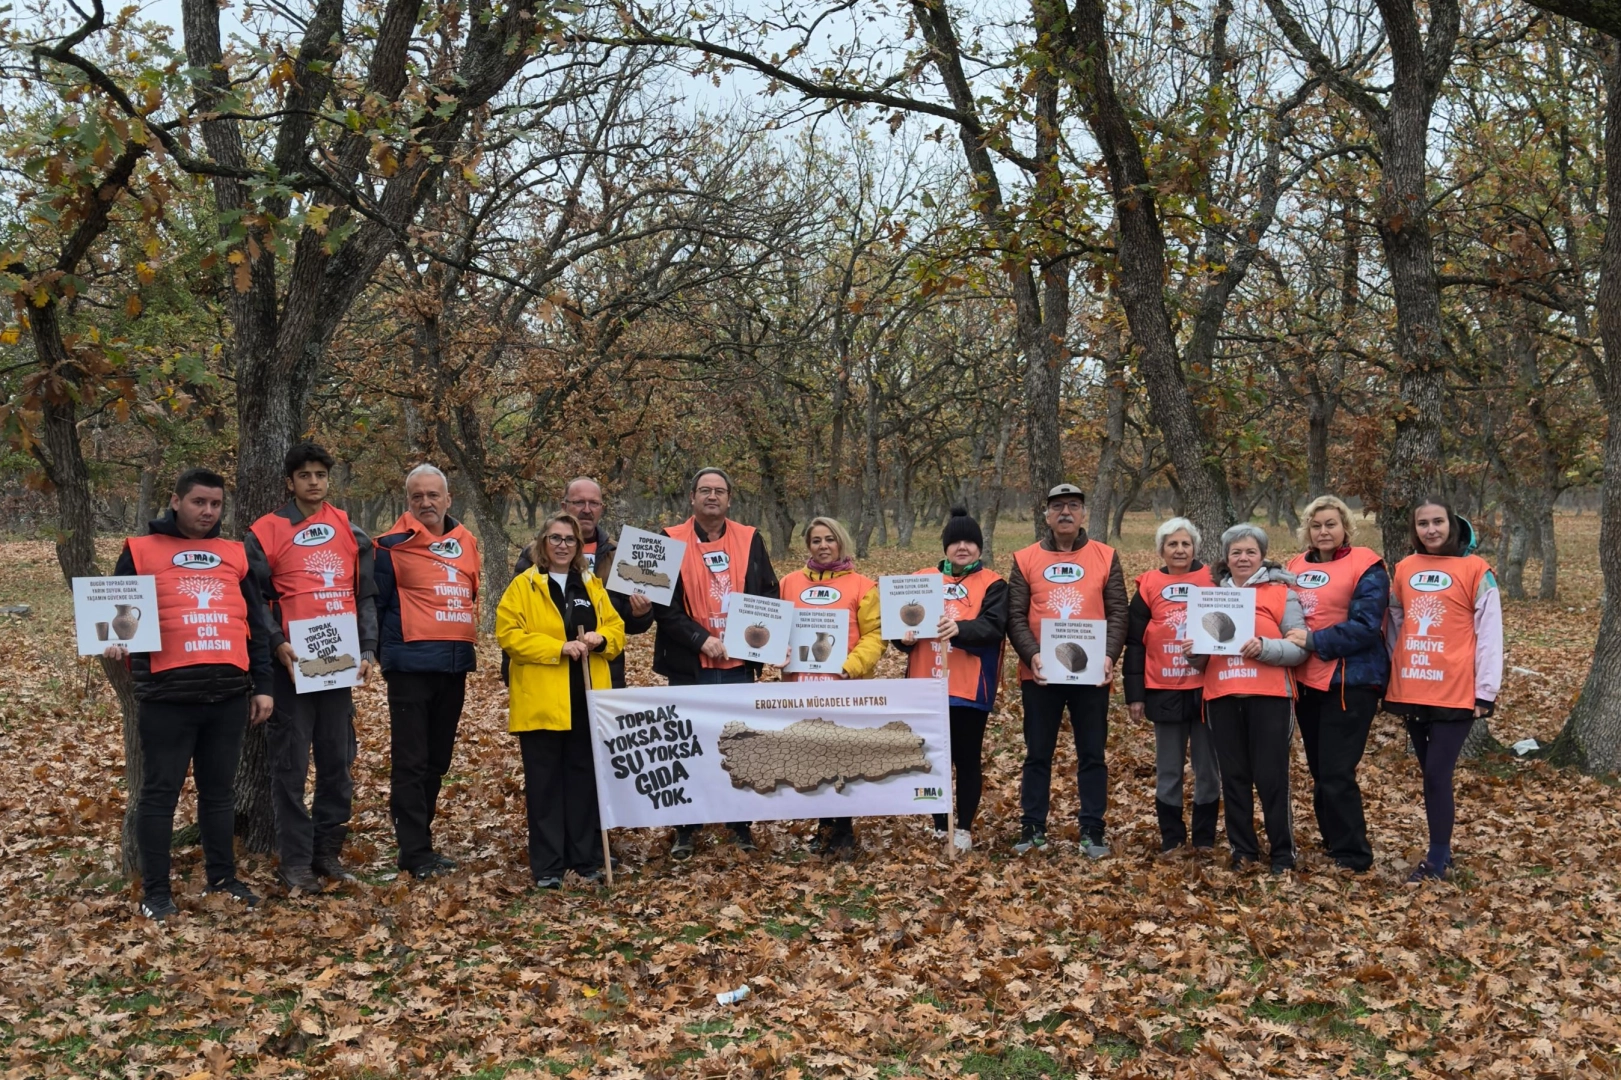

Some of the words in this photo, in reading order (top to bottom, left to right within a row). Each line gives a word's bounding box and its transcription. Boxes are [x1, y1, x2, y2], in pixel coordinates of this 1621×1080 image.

[302, 527, 324, 540] TEMA
[639, 536, 662, 546] TOPRAK
[183, 553, 209, 563] TEMA
[631, 550, 645, 561] SU
[645, 551, 667, 563] YOKSA
[637, 560, 659, 570] GIDA
[1051, 566, 1074, 576] TEMA
[1303, 573, 1322, 582] TEMA
[1418, 574, 1440, 583] TEMA
[809, 589, 829, 599] TEMA
[326, 598, 344, 613] ÇÖL
[182, 610, 229, 625] TÜRKİYE
[197, 624, 220, 639] ÇÖL
[308, 622, 332, 634] TOPRAK
[304, 633, 326, 644] YOKSA
[307, 641, 321, 653] SU
[320, 636, 343, 649] YOKSA
[1406, 636, 1444, 653] ÜRKİYE
[184, 639, 232, 653] OLMASIN
[317, 646, 338, 660] GIDA
[1411, 651, 1431, 667] ÇÖL
[1218, 668, 1257, 680] OLMASIN
[755, 698, 805, 710] EROZYONLA
[806, 695, 851, 708] MÜCADELE
[852, 696, 887, 707] HAFTASI
[615, 704, 679, 731] TOPRAK
[603, 726, 663, 755] YOKSA
[611, 749, 645, 780] SU
[644, 739, 704, 763] YOKSA
[635, 760, 690, 795] GIDA
[647, 787, 693, 810] YOK.
[913, 787, 937, 798] TEMA
